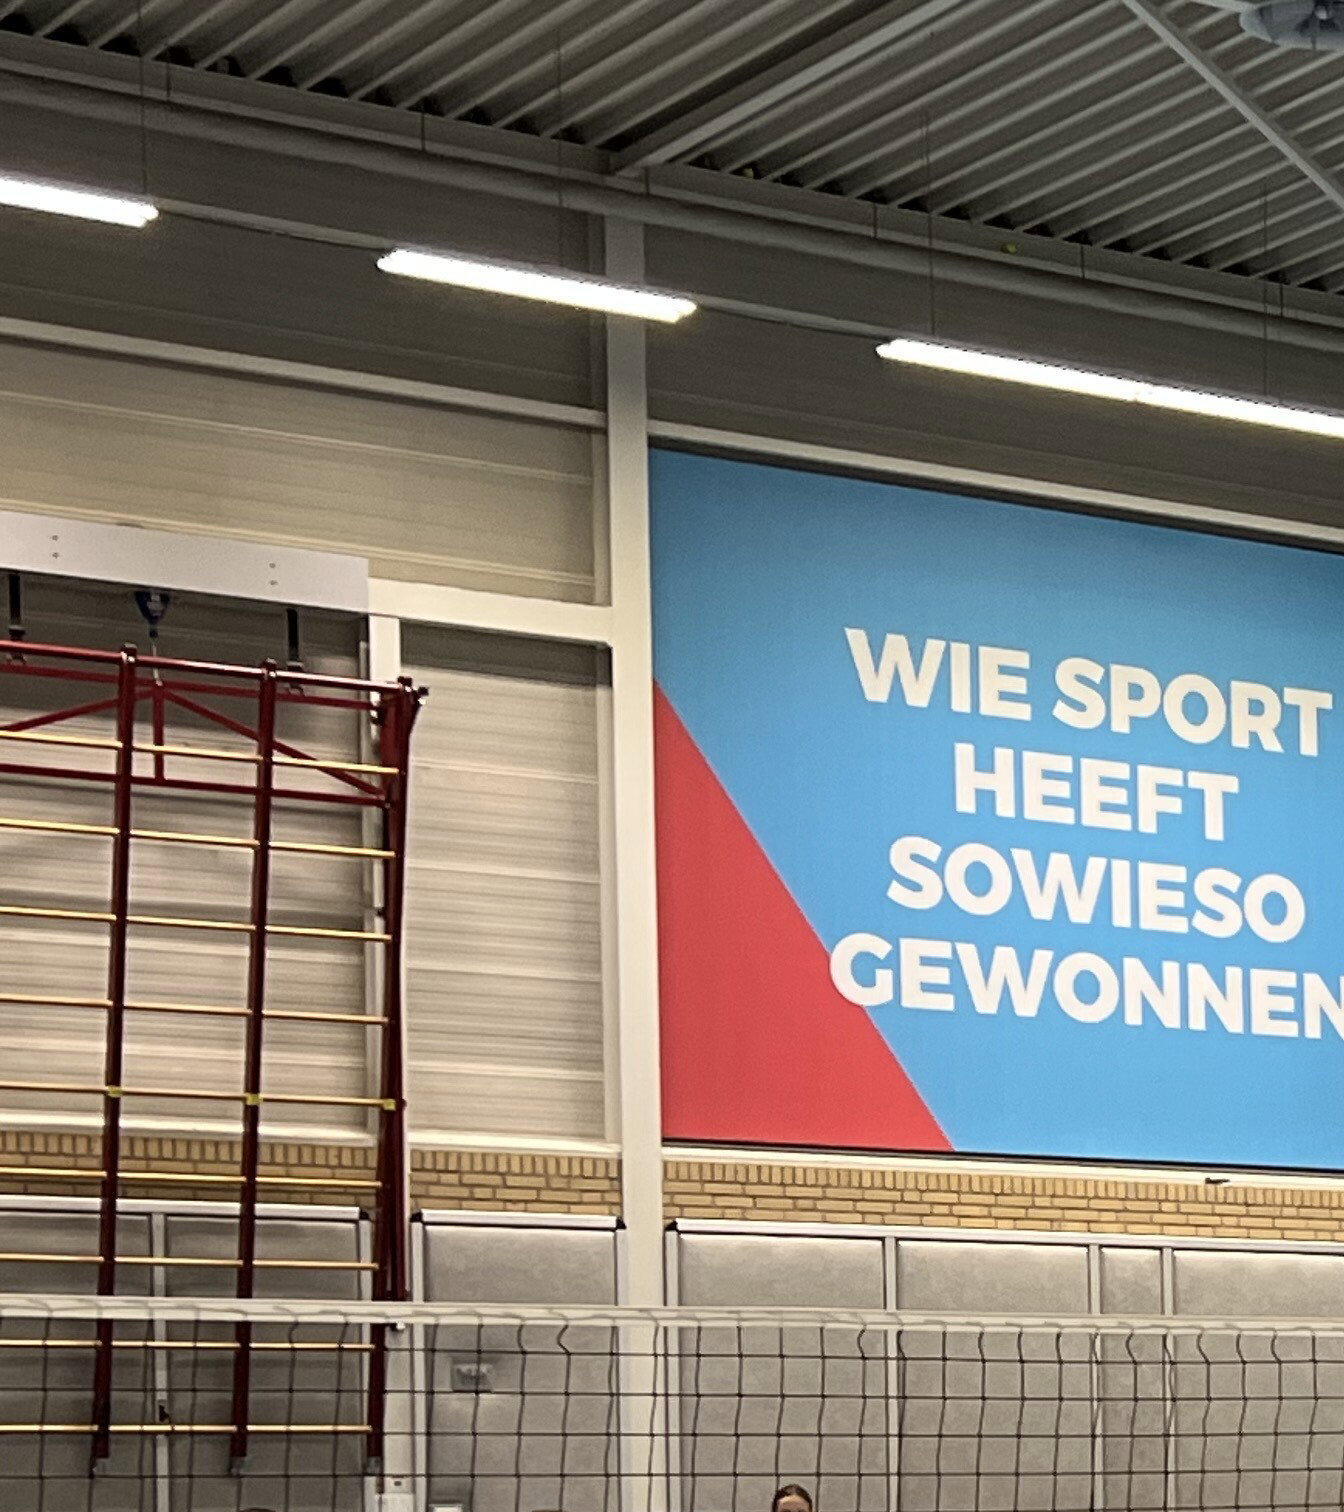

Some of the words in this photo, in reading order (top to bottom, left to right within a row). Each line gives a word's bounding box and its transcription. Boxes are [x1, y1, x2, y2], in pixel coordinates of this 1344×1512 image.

[844, 627, 1032, 719] WIE
[1052, 656, 1334, 758] SPORT
[953, 742, 1239, 842] HEEFT
[886, 835, 1306, 944] SOWIESO
